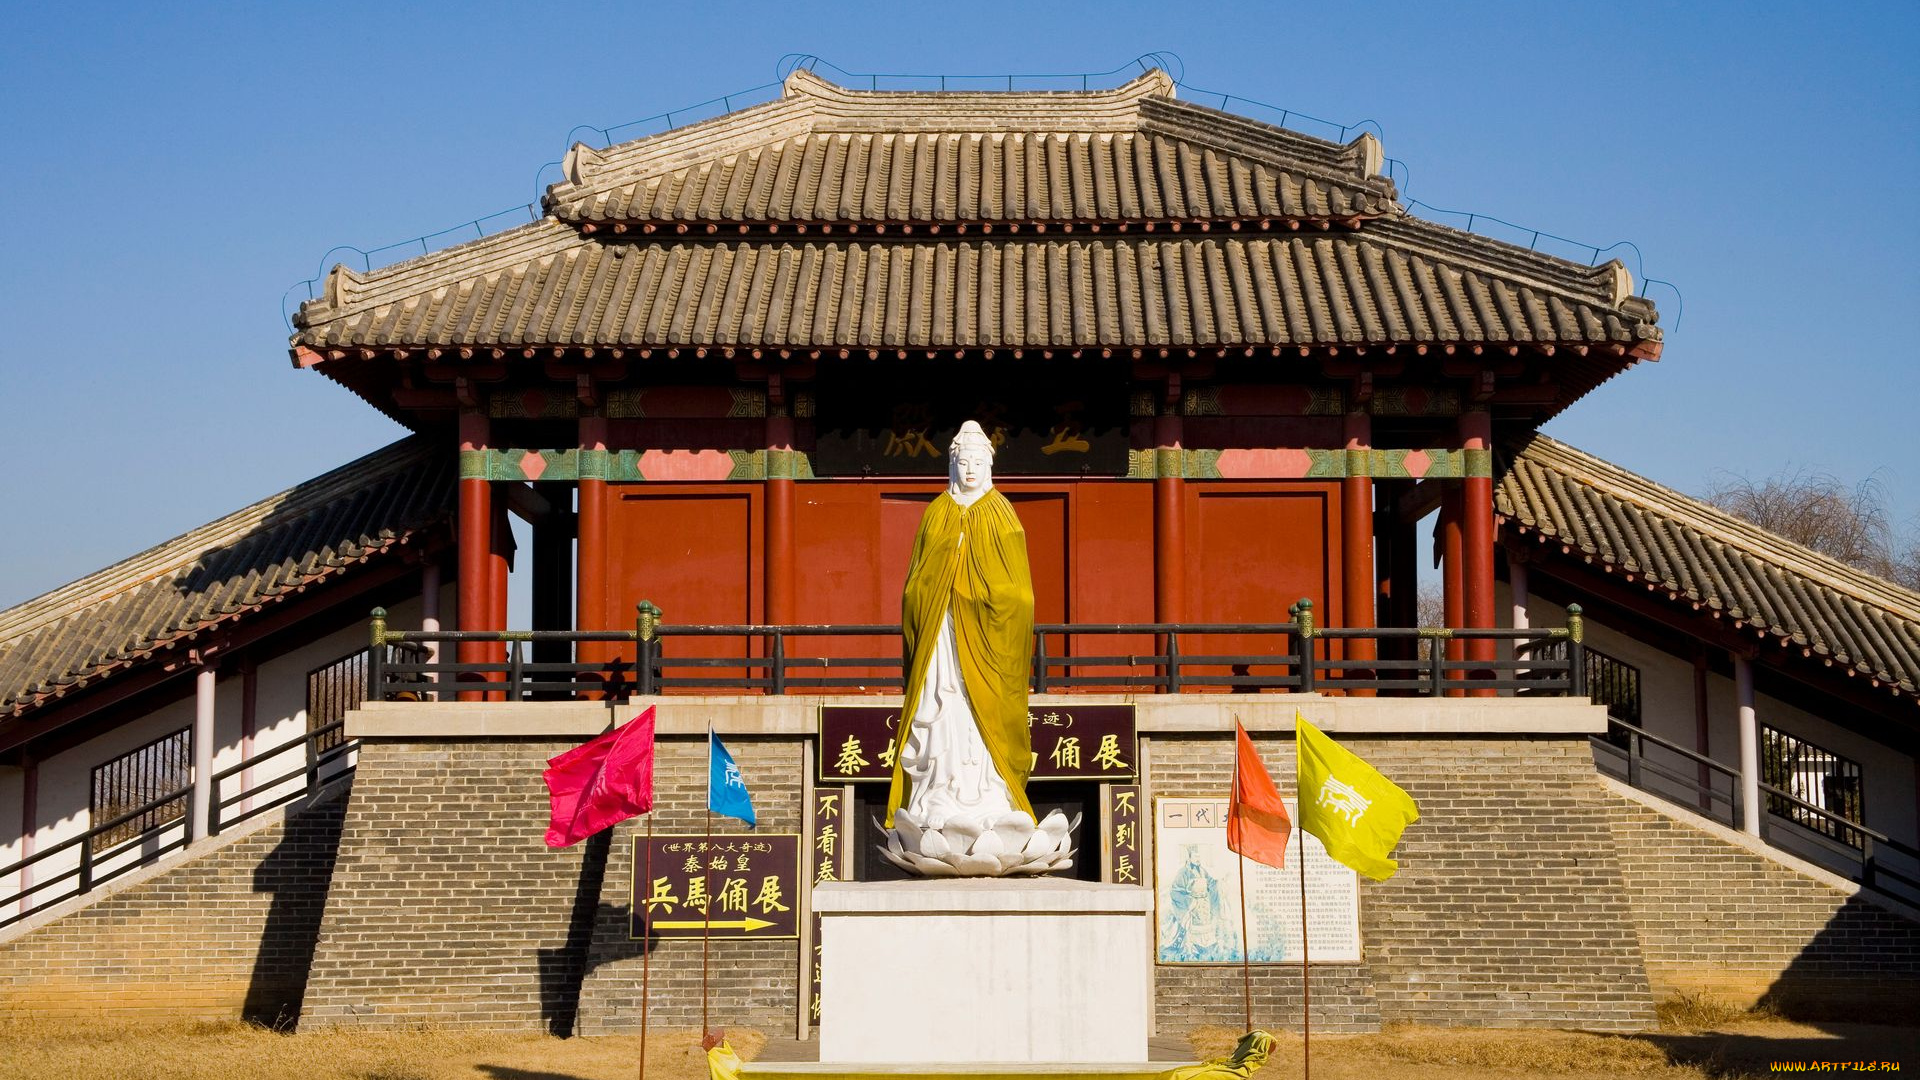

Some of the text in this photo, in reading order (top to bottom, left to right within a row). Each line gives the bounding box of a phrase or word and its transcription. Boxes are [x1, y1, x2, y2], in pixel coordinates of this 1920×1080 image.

[1030, 733, 1129, 772] 俑展
[662, 841, 773, 854] (世界第八大奇迹)
[1114, 791, 1137, 884] 不到長
[682, 853, 752, 874] 秦始皇
[641, 875, 791, 916] 兵馬俑展
